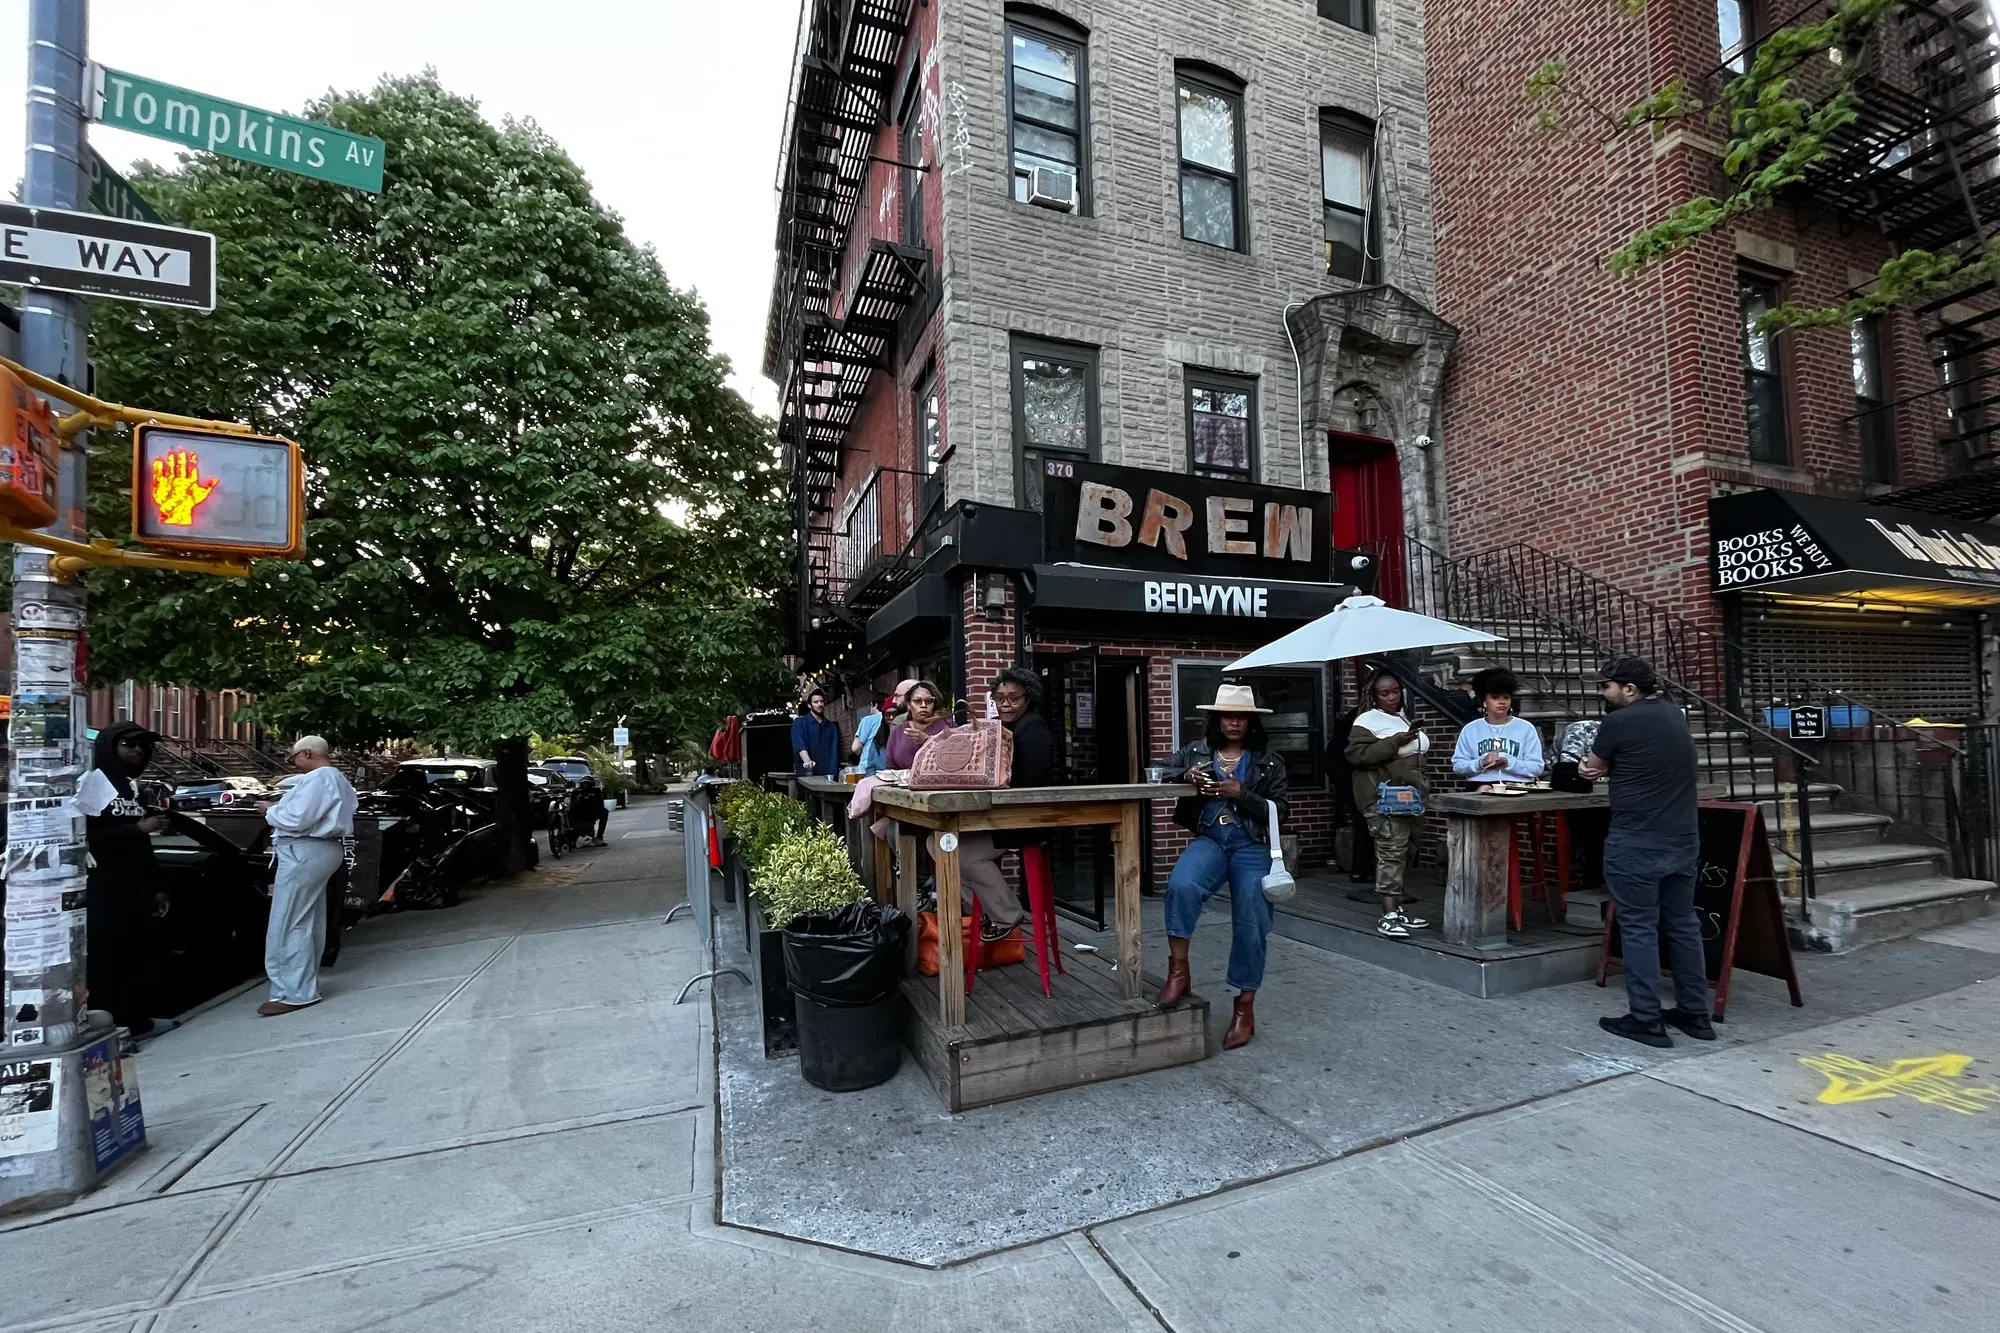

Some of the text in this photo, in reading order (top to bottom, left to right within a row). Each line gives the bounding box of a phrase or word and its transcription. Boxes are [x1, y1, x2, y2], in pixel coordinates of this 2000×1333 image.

[111, 77, 375, 168] Tompkins Av
[76, 238, 171, 279] WAY
[1047, 461, 1073, 478] 370
[1075, 480, 1312, 561] BREW
[1718, 528, 1783, 553] BOOKS
[1718, 542, 1793, 569] BOOKS
[1790, 523, 1832, 569] WE BUY
[1718, 556, 1804, 586] BOOKS
[1144, 581, 1267, 617] BED-VYNE
